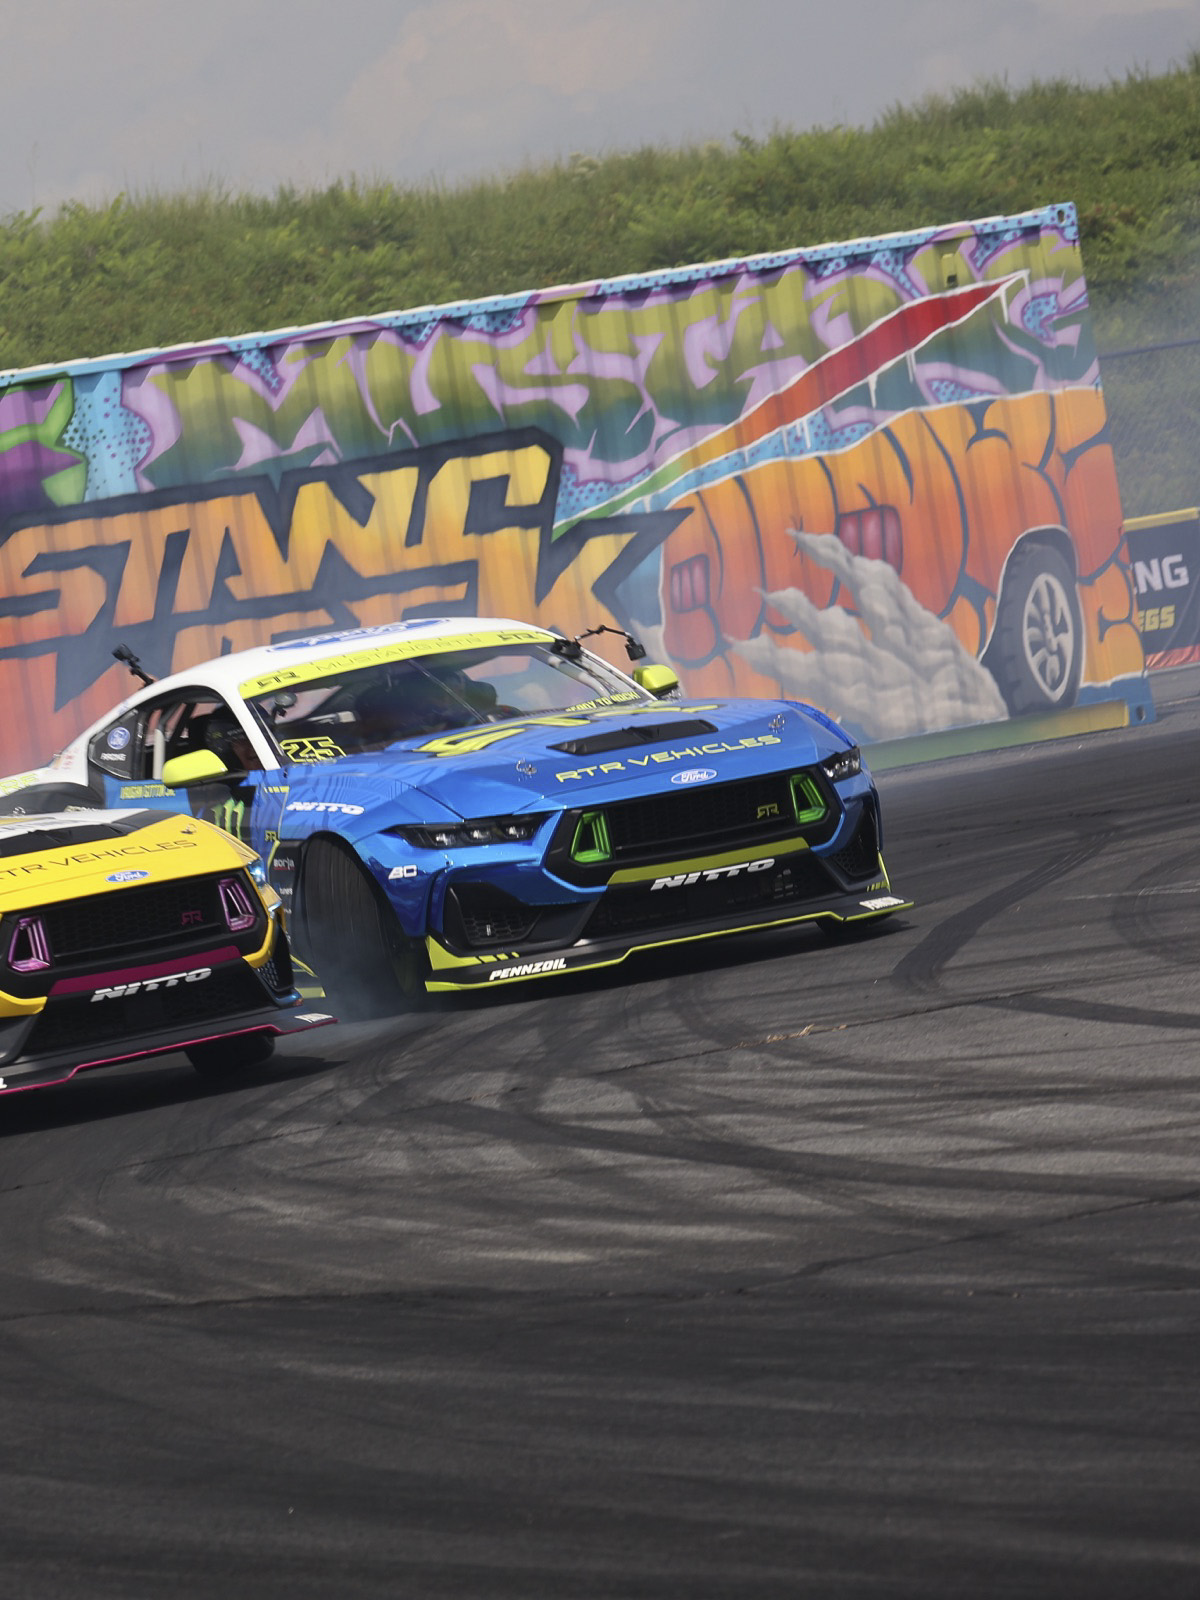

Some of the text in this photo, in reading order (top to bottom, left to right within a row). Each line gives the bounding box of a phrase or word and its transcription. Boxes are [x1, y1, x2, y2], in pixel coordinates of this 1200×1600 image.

[315, 643, 432, 673] MUSTANG
[280, 736, 347, 763] 25
[556, 734, 782, 783] RTR VEHICLES
[676, 768, 713, 784] Ford
[286, 802, 365, 816] NITTO
[49, 839, 198, 867] VEHICLES
[111, 870, 147, 883] Ford
[650, 858, 775, 891] NITTO
[489, 958, 567, 982] PENNZOIL
[90, 967, 211, 1002] NITTO
